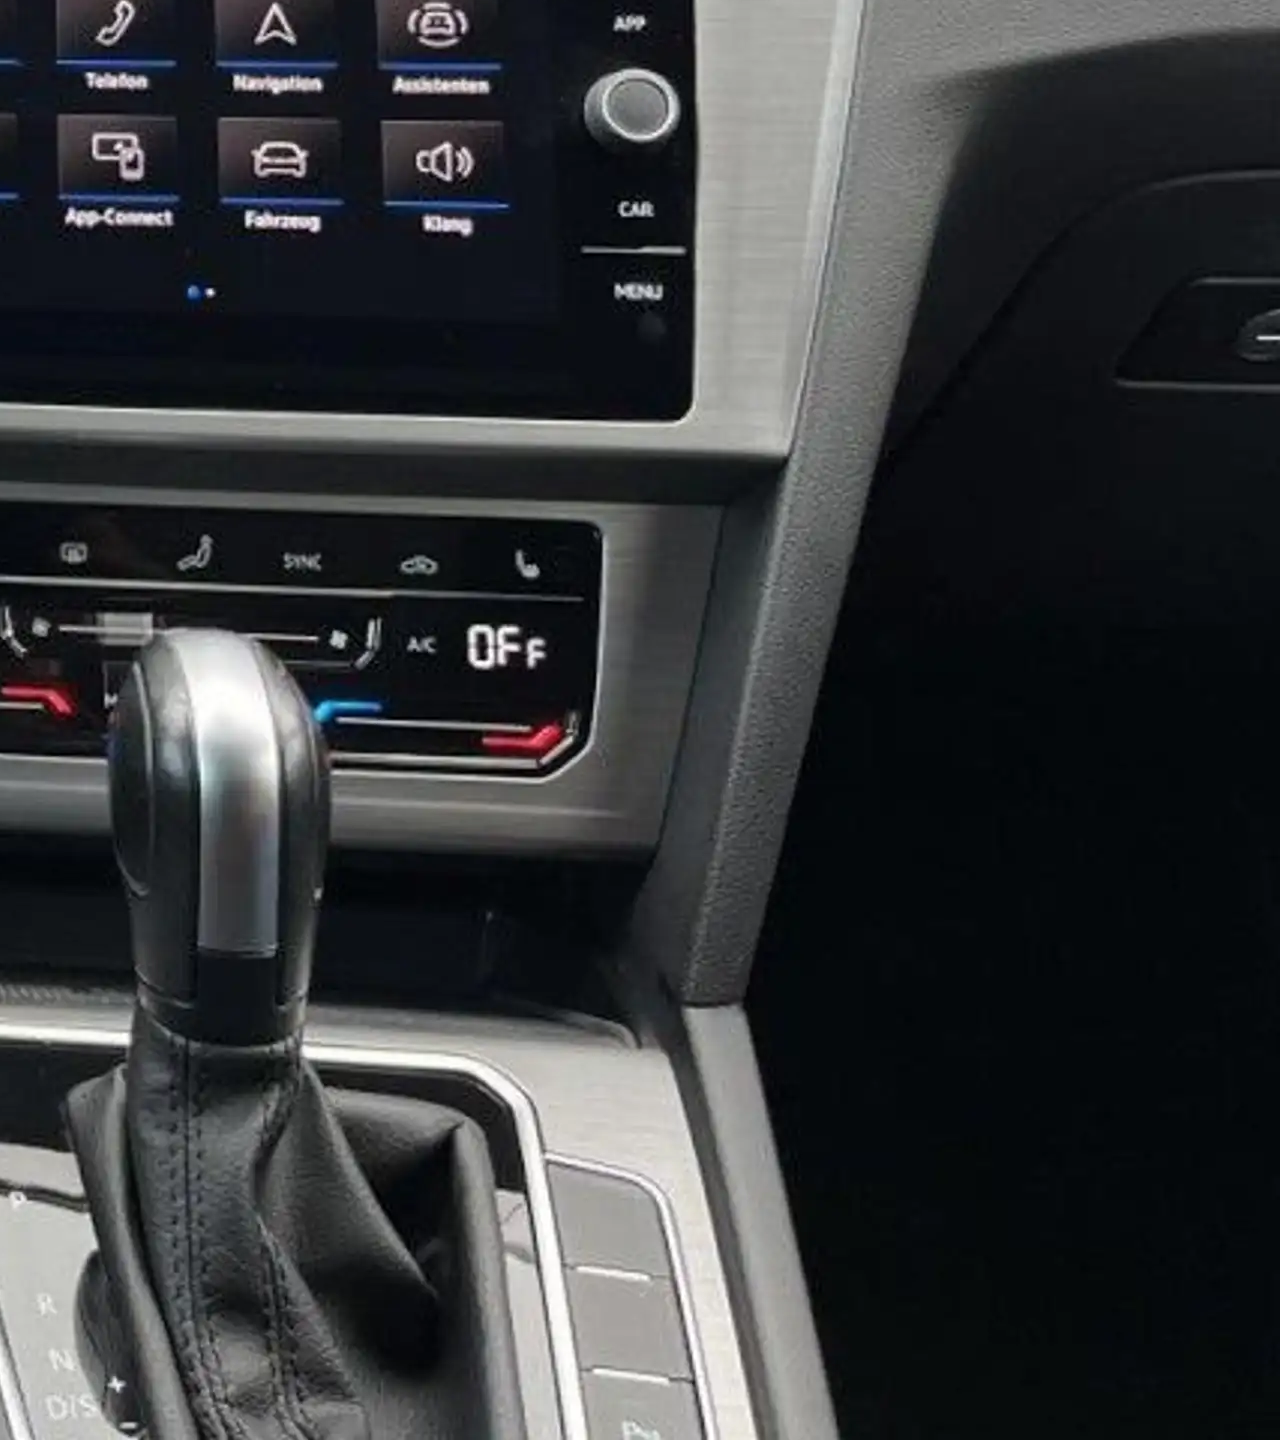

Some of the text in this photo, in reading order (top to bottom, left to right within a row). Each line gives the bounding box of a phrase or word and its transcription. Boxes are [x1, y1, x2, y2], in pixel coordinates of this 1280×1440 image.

[613, 15, 647, 32] APP
[85, 71, 149, 91] Telefon
[233, 73, 324, 94] Navigation
[392, 75, 490, 95] Assistenten
[65, 208, 174, 229] App-Connect
[618, 201, 654, 218] CAR
[244, 209, 322, 234] Fahrzeug
[423, 214, 474, 237] Klang
[614, 283, 664, 301] MENU
[283, 552, 323, 573] SYNC
[407, 636, 437, 655] A/C
